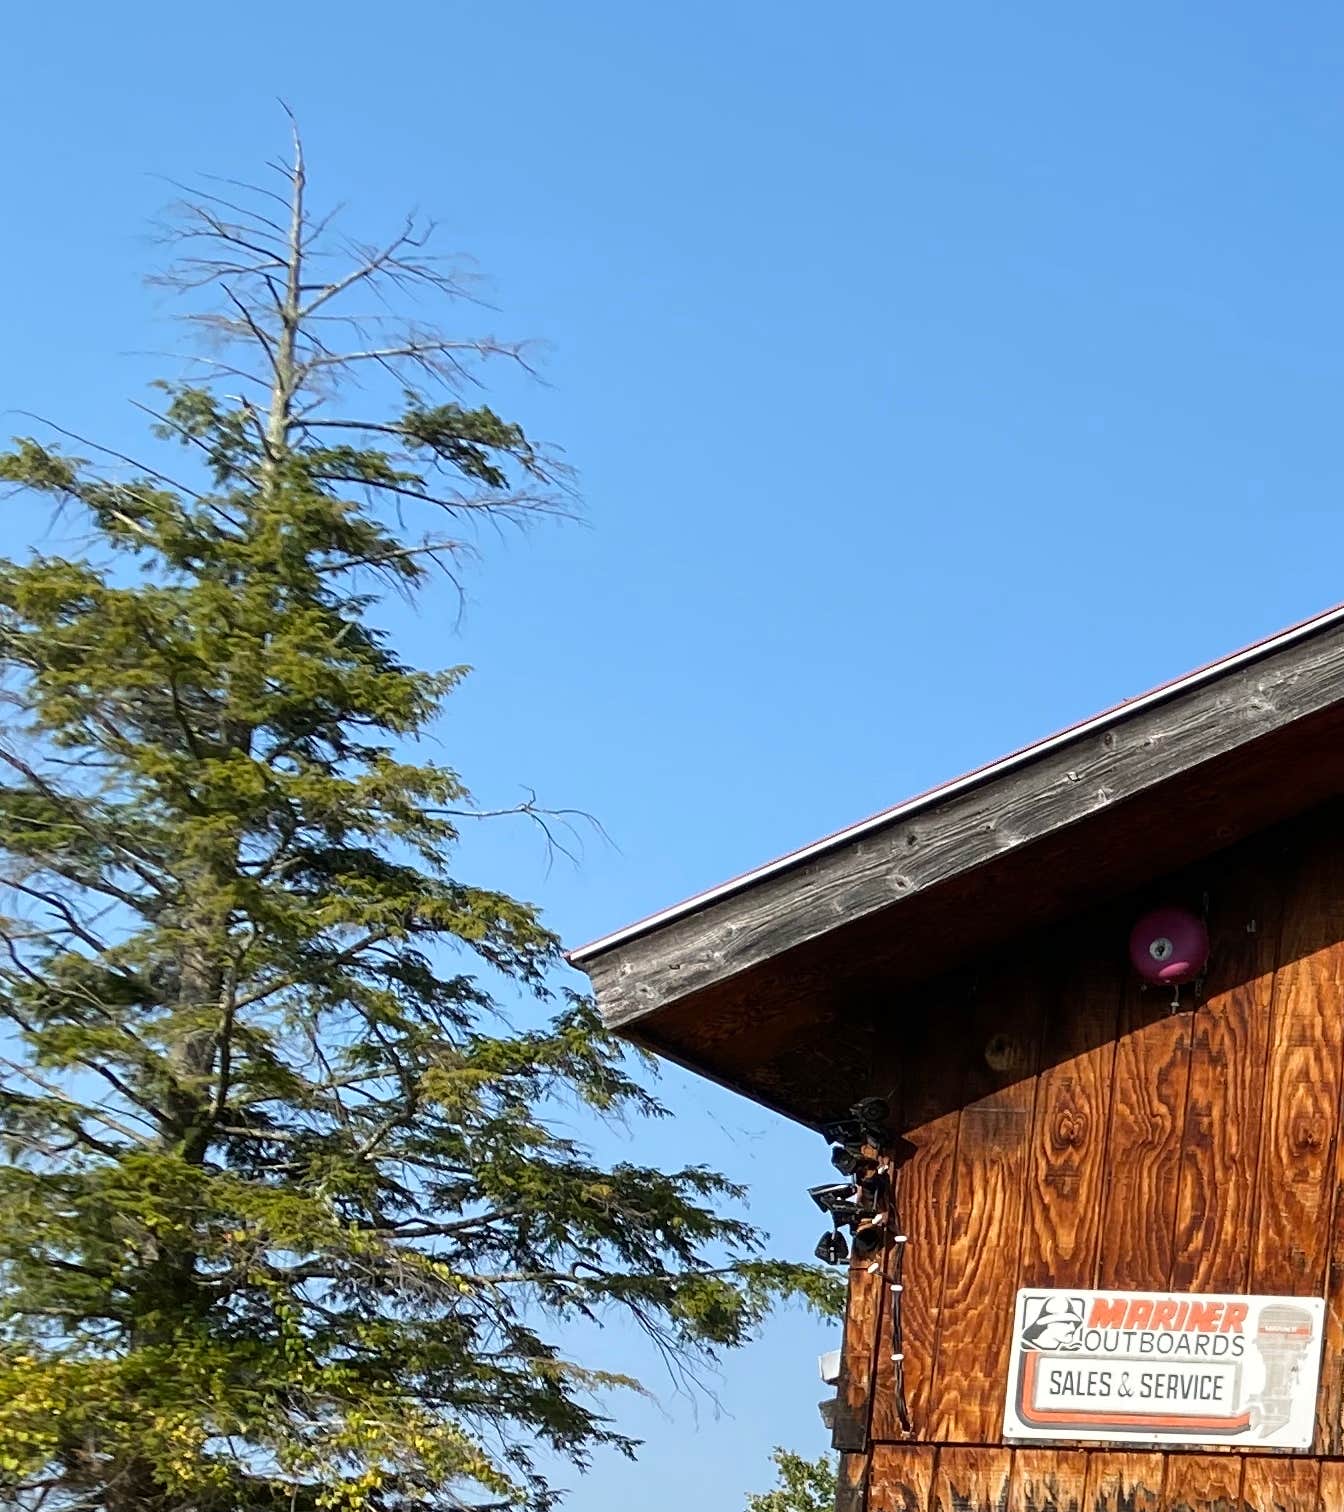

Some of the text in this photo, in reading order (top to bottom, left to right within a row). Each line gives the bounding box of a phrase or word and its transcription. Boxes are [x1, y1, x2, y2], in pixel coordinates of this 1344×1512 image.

[1087, 1297, 1250, 1333] MARINER
[1084, 1329, 1246, 1357] OUTBOARDS
[1049, 1370, 1224, 1401] SALES & SERVICE
